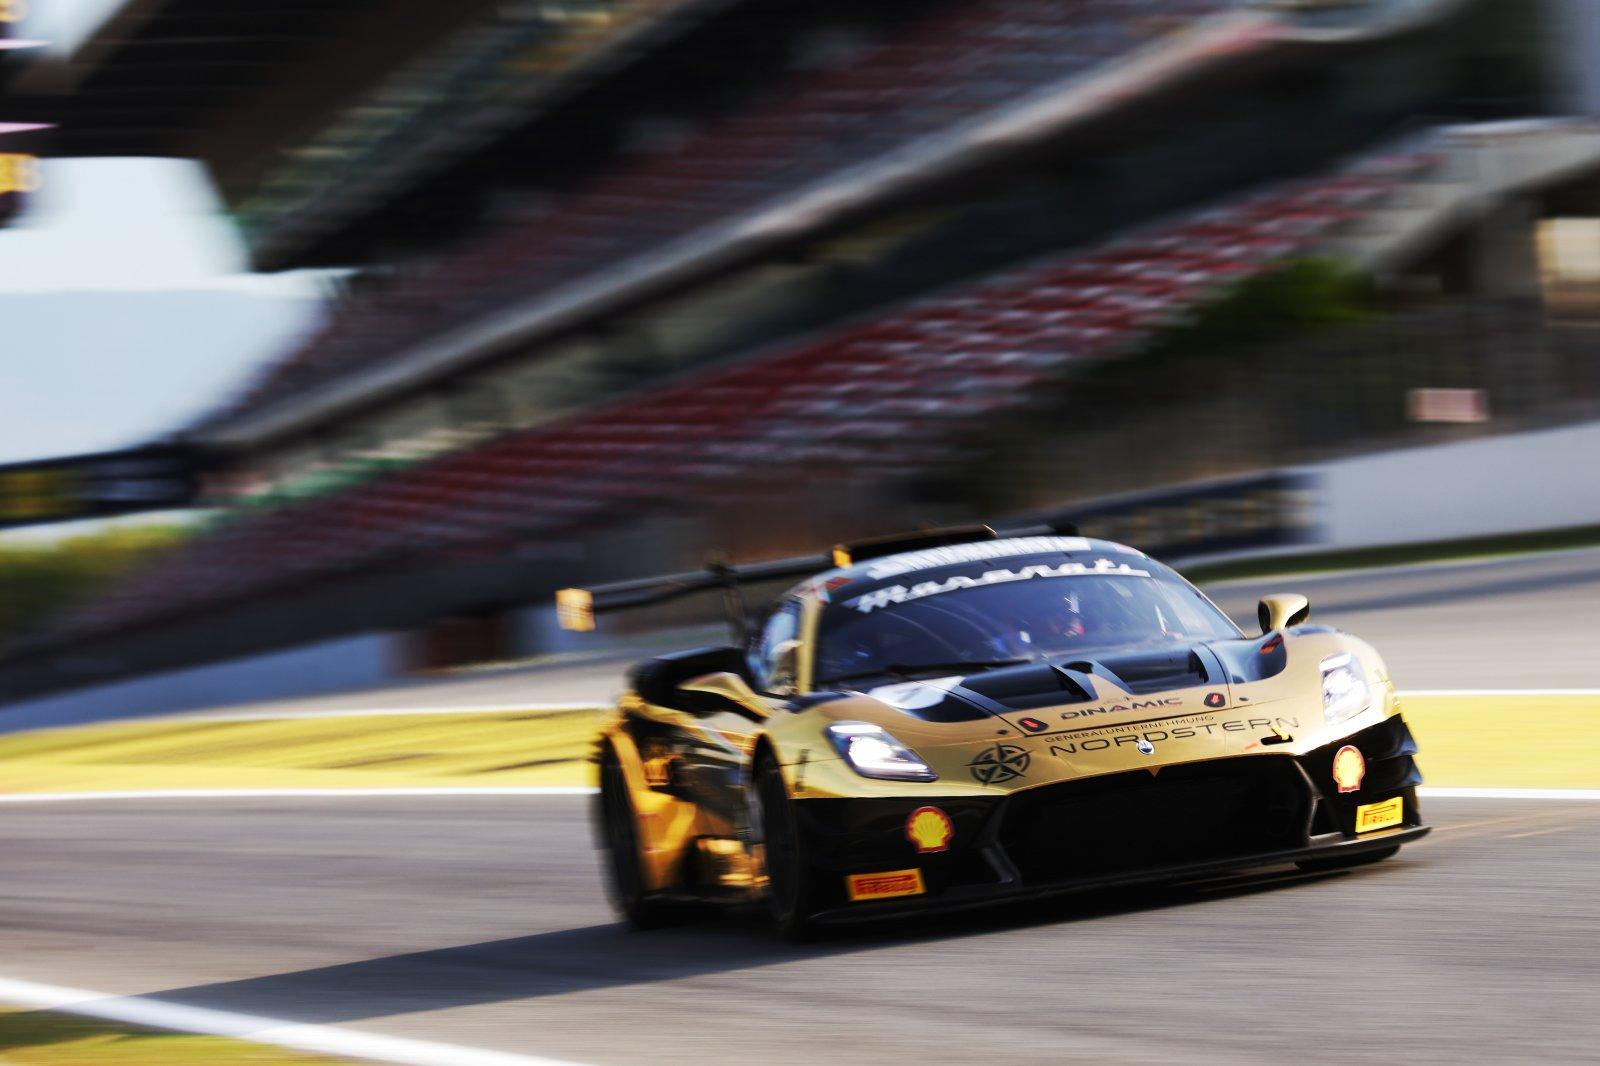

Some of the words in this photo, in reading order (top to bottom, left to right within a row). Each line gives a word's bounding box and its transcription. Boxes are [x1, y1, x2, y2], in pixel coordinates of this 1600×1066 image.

[1060, 697, 1183, 720] DINAMIC
[1045, 715, 1214, 743] GENERALUNTERNEHMUNG
[1049, 716, 1300, 757] NORDSTERN
